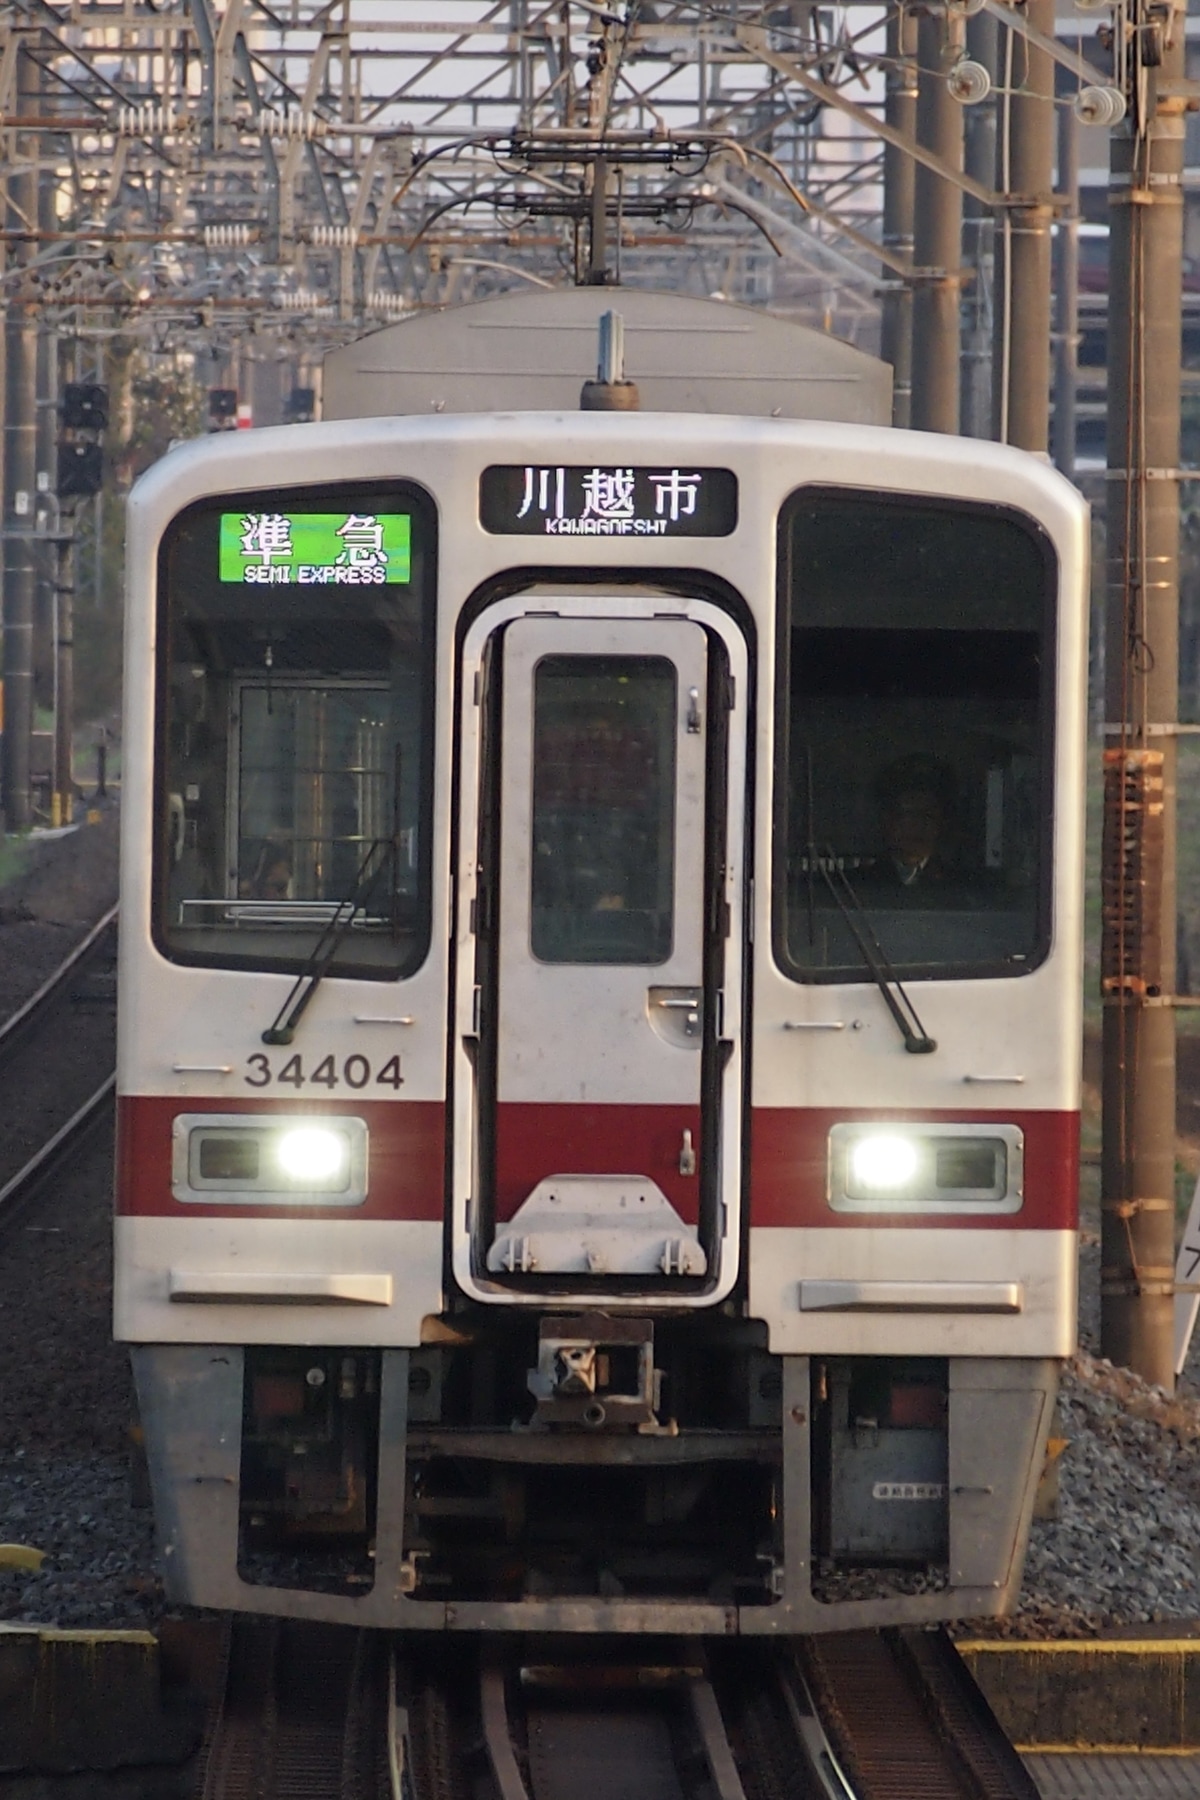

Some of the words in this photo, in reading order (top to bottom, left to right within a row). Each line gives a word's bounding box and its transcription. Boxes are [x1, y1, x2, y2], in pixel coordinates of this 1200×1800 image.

[516, 467, 702, 521] 川越市
[239, 514, 389, 567] 準急
[244, 565, 291, 584] SEMI
[297, 565, 387, 585] EXPRESS
[244, 1053, 405, 1090] 34404
